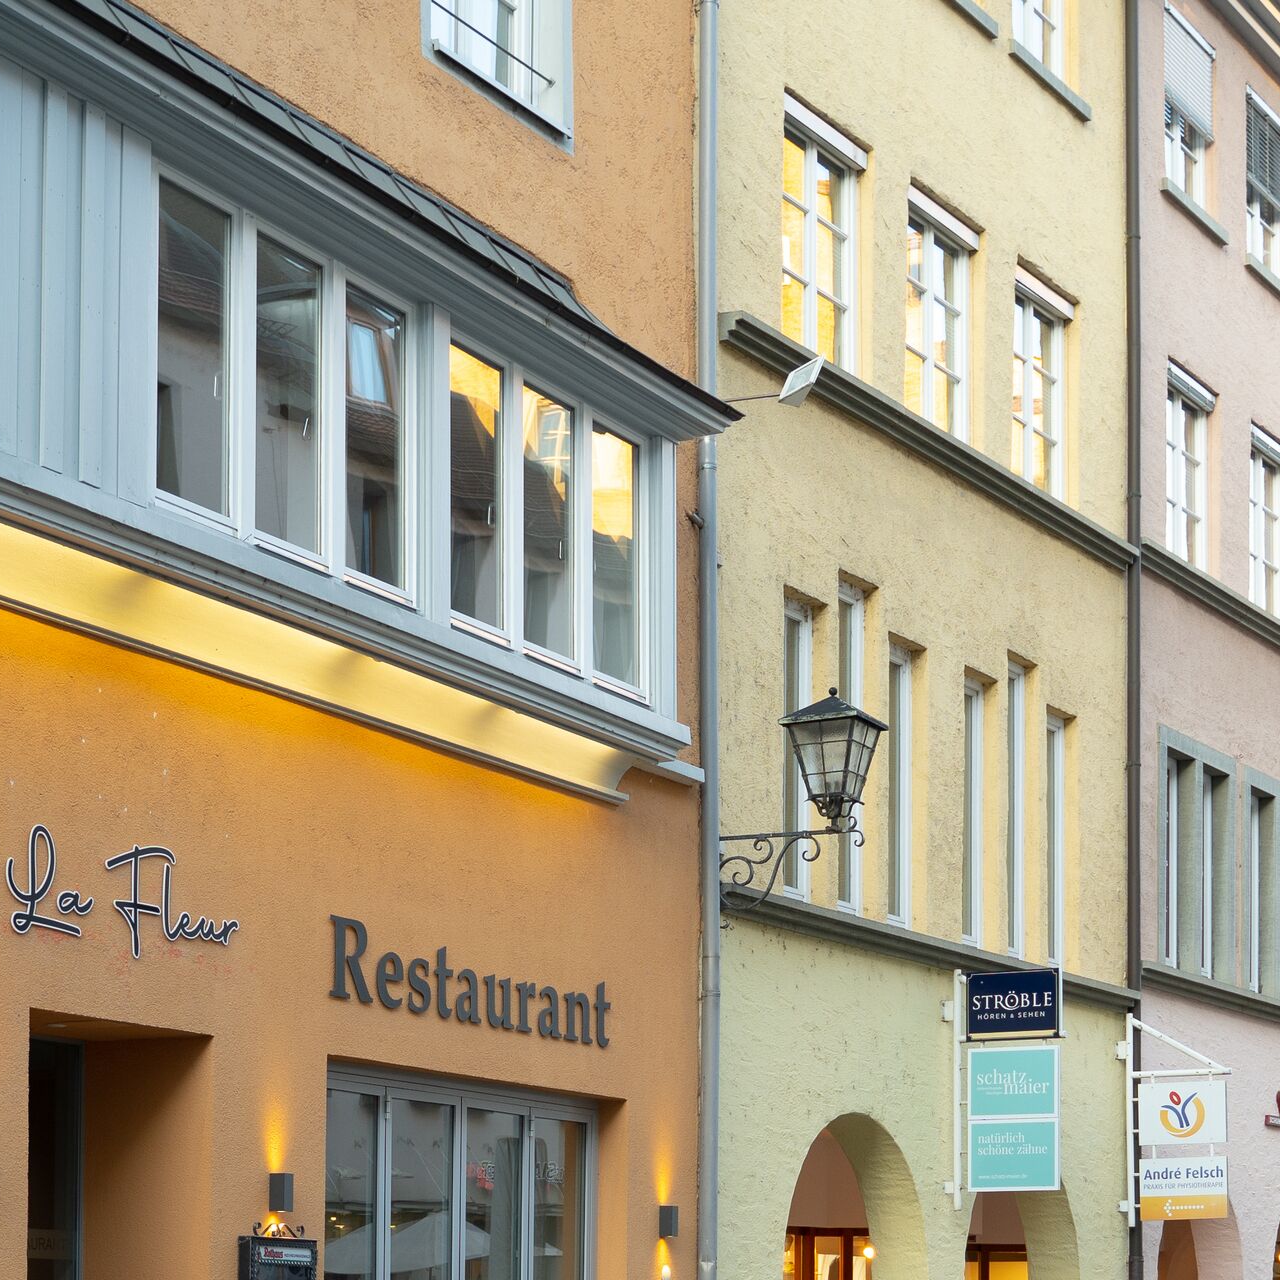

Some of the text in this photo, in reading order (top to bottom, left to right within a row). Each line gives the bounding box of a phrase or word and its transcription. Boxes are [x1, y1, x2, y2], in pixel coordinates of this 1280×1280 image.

[6, 824, 240, 959] La Fleur
[329, 913, 612, 1048] Restaurant
[972, 990, 1052, 1011] STRÖBLE
[977, 1012, 1007, 1020] HÖREN
[976, 1068, 1027, 1085] schatz
[1004, 1078, 1050, 1095] maier
[978, 1132, 1025, 1144] natürlich
[977, 1143, 1048, 1155] schöne zähne
[1144, 1165, 1224, 1180] André Felsch
[1177, 1181, 1224, 1189] PHYSIOTHERAPIE
